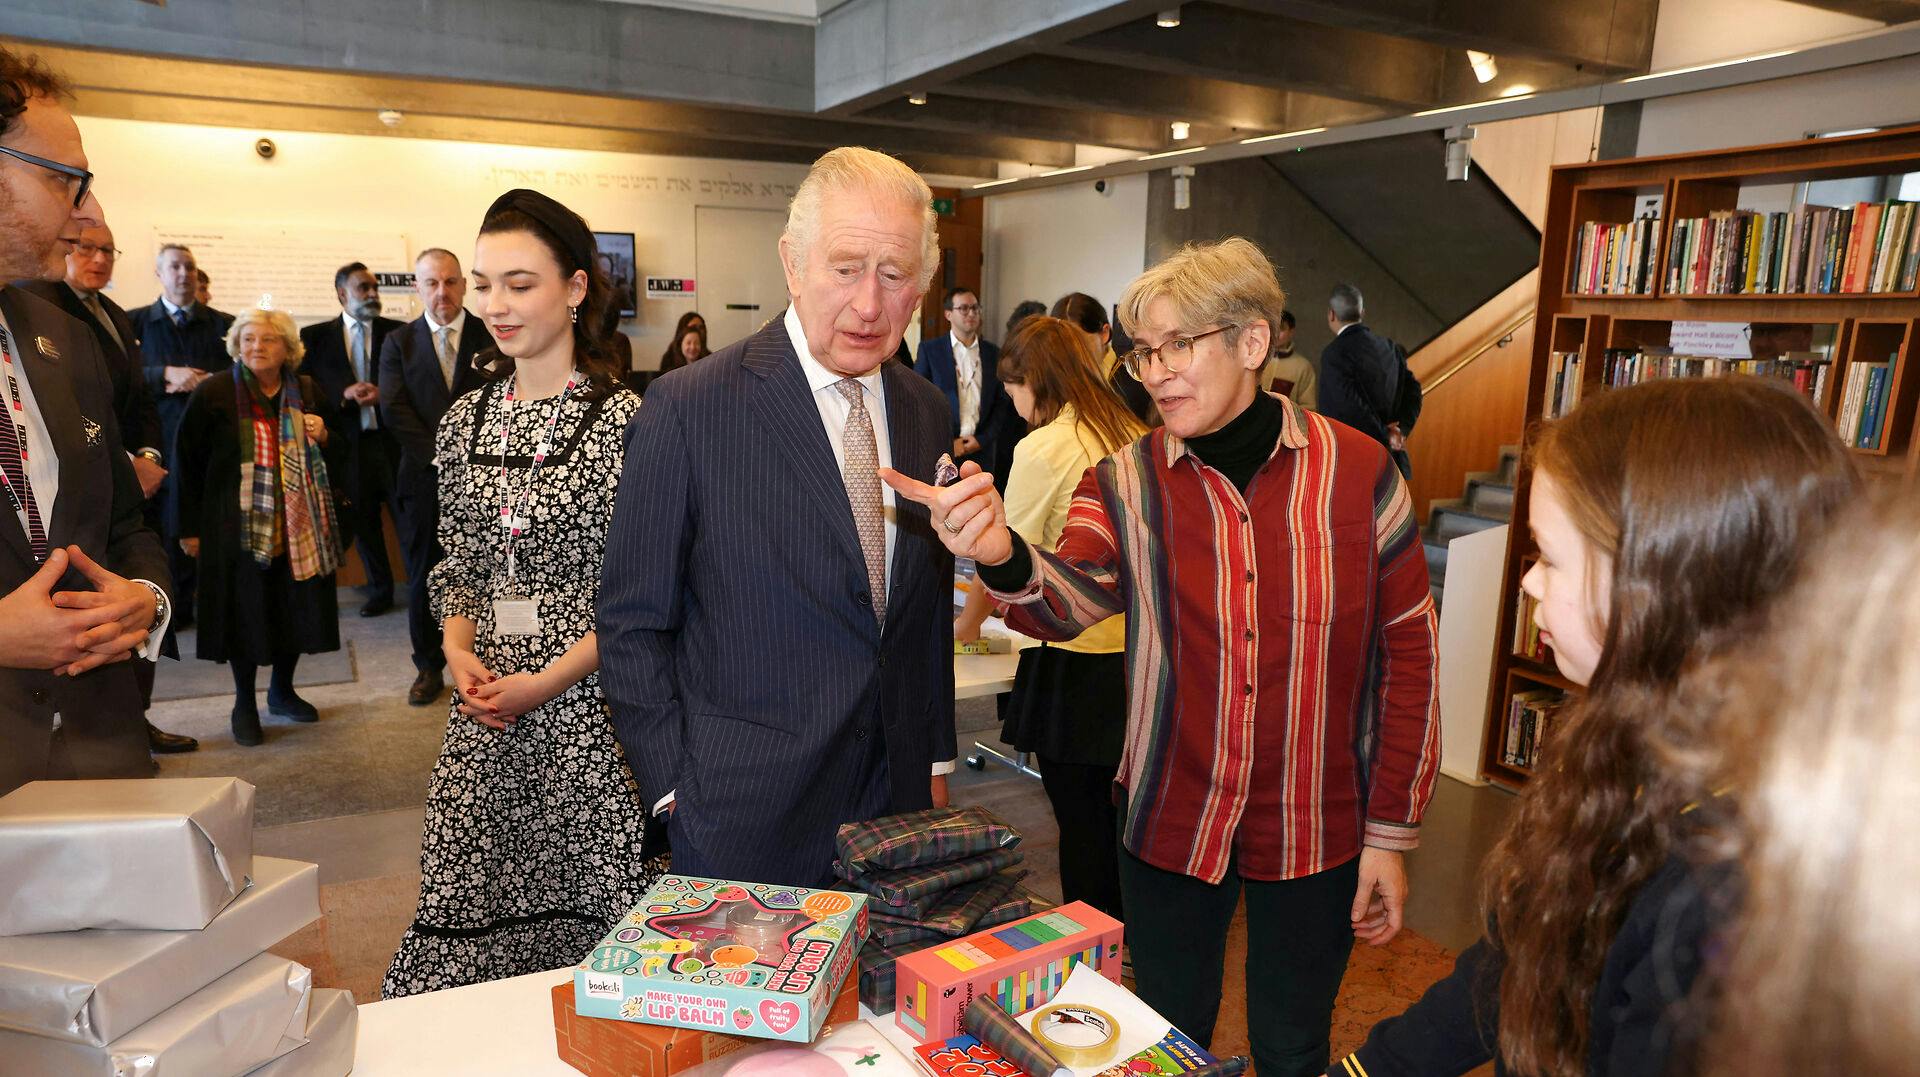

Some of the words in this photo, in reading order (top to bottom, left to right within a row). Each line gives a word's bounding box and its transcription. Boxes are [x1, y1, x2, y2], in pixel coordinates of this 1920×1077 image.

[795, 941, 833, 973] BALM
[782, 971, 814, 993] LIP
[647, 991, 673, 1002] MAKE
[676, 994, 703, 1005] YOUR
[706, 998, 726, 1009] OWN
[648, 1003, 676, 1019] LIP
[679, 1007, 725, 1026] BALM
